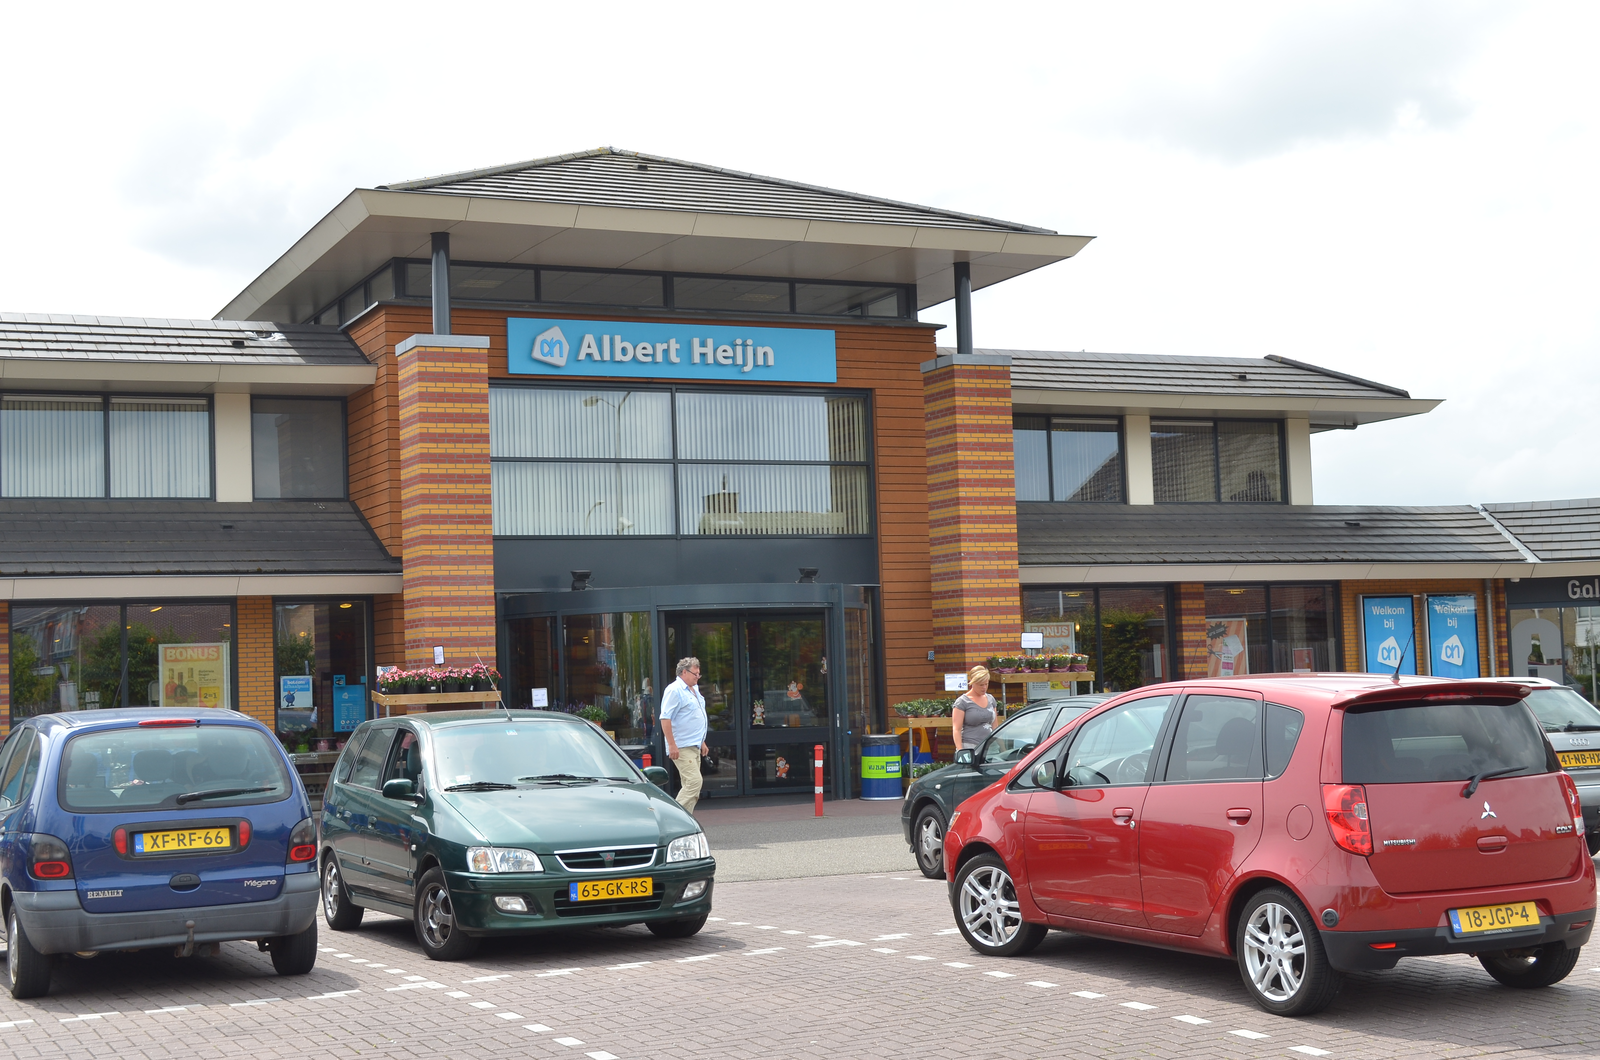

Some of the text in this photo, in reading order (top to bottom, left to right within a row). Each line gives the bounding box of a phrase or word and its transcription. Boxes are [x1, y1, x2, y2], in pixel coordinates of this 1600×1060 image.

[577, 334, 775, 373] Albert Heijn
[1372, 606, 1405, 615] Welkom
[1435, 605, 1468, 614] Welkom
[1384, 619, 1395, 630] bij
[1447, 618, 1458, 629] bij
[1031, 626, 1069, 636] BONUS
[166, 647, 219, 660] BONUS
[150, 831, 224, 849] XF-RF-66
[87, 890, 123, 899] RENAULT
[581, 880, 648, 898] 65-GK-RS
[1465, 906, 1530, 928] 18-JGP-4
